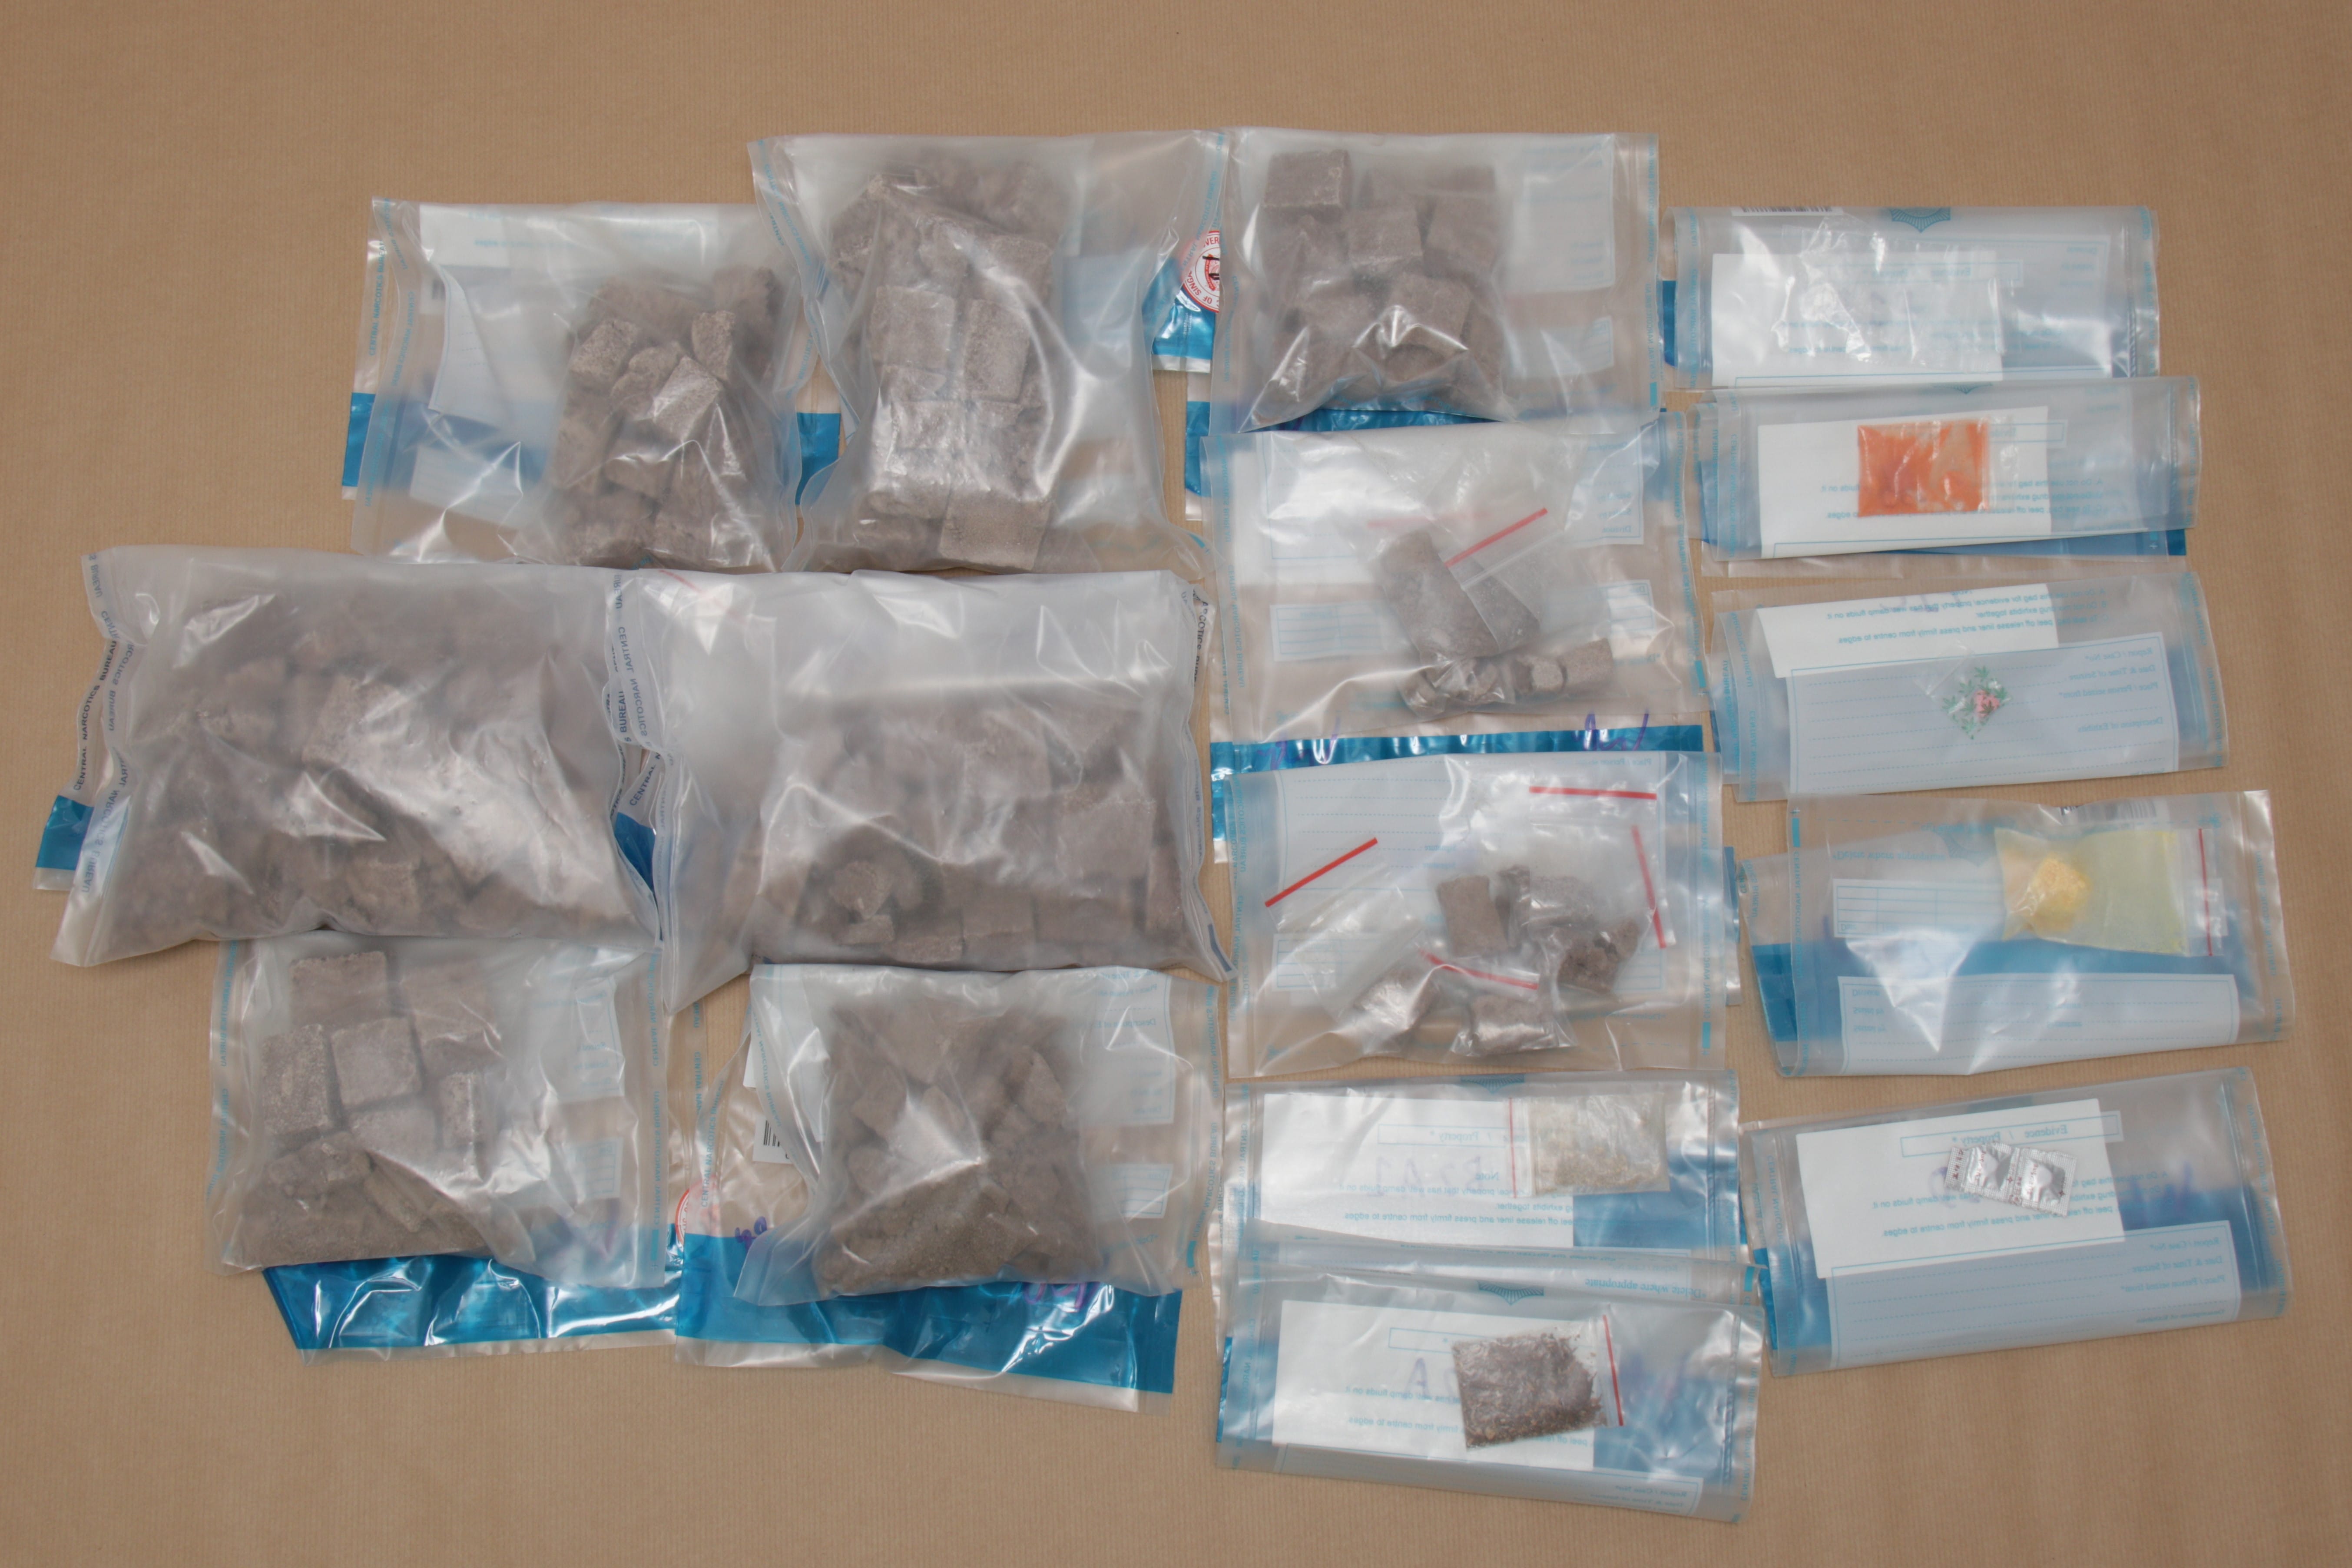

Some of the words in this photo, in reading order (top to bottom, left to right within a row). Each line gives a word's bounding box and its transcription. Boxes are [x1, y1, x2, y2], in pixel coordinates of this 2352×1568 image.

[373, 274, 384, 318] NARCOTICS
[1202, 296, 1212, 305] OF
[369, 320, 379, 355] CENTRAL
[73, 745, 88, 791] CENTRAL
[81, 685, 101, 741] NARCOTICS
[99, 639, 117, 681] BUREAU
[619, 691, 627, 733] BUREAU
[629, 764, 656, 807] CENTRAL
[706, 1116, 717, 1165] NARCOTICS
[701, 1167, 713, 1208] CENTRAL
[1583, 1278, 1638, 1292] appropriate
[1640, 1283, 1670, 1296] where
